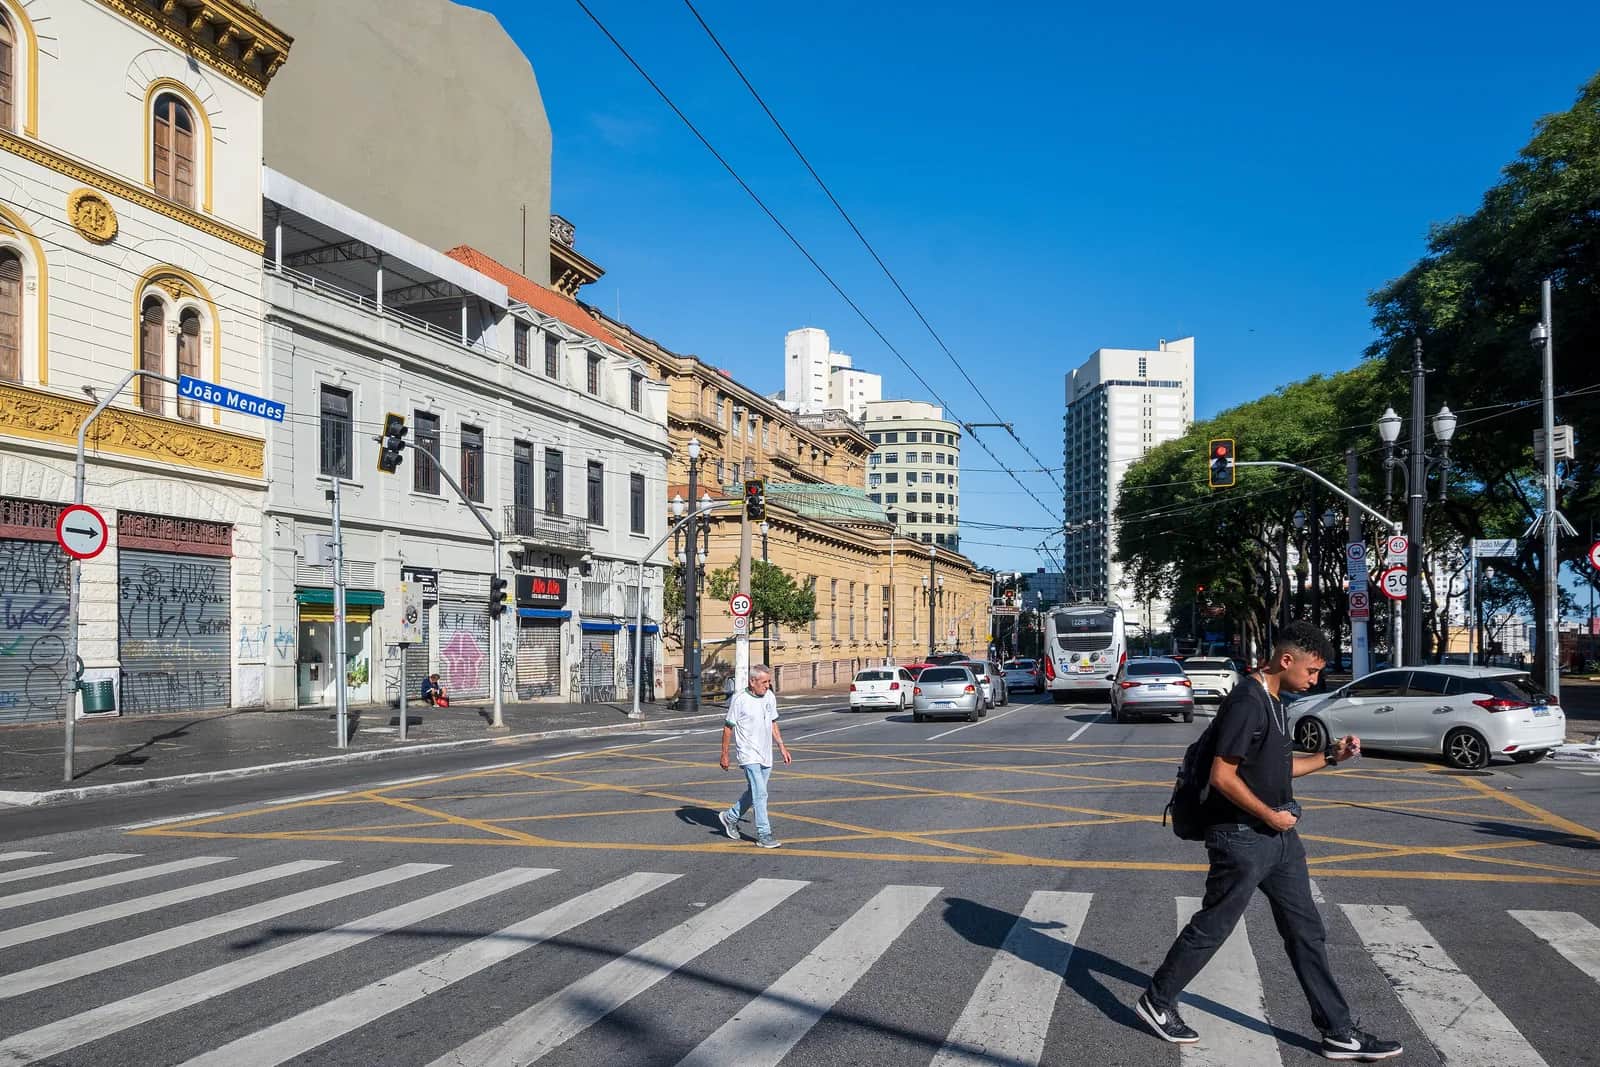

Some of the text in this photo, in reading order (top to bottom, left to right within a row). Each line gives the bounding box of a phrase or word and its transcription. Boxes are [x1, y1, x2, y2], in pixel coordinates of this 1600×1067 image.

[182, 381, 282, 418] João Mendes
[1388, 574, 1407, 588] 50
[734, 600, 748, 610] 50
